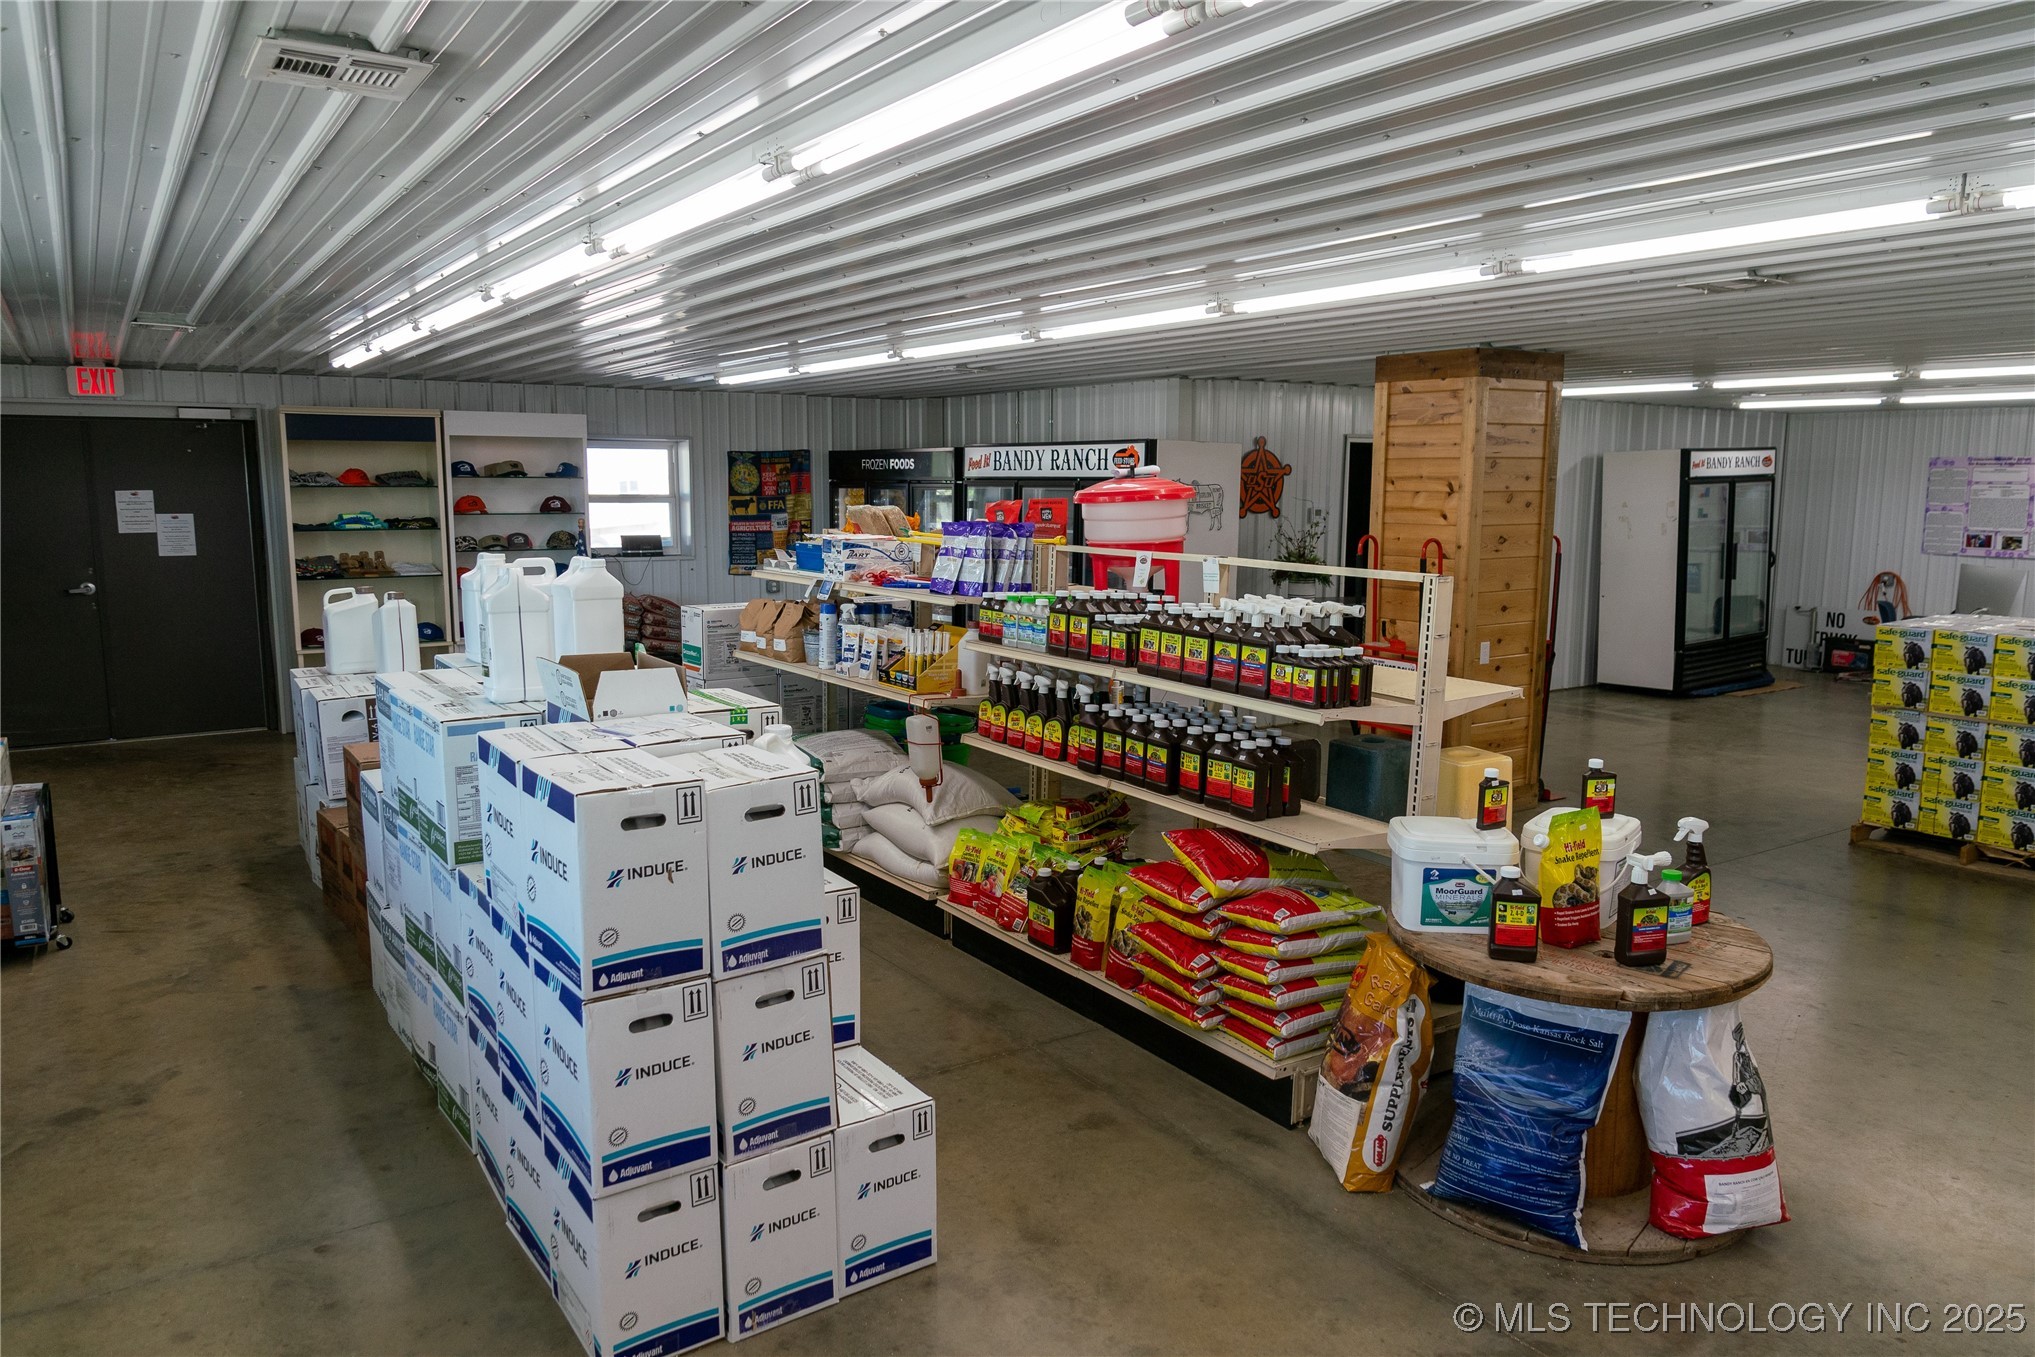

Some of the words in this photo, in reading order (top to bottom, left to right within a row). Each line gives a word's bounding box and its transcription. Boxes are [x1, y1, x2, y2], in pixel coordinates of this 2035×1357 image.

[75, 367, 116, 395] EXIT
[861, 458, 889, 470] FROZEN
[889, 458, 915, 470] FOODS
[993, 448, 1046, 471] BANDY
[1049, 448, 1109, 471] RANCH
[1706, 456, 1733, 469] BANDY
[1735, 455, 1760, 468] RANCH
[768, 500, 785, 510] FFA
[1826, 611, 1846, 629] NO
[1878, 628, 1927, 639] safe-guard
[1938, 631, 1988, 643] safe-guard
[1877, 667, 1925, 679] safe-guard
[1936, 673, 1986, 686] safe-guard
[1871, 747, 1918, 760] safe-guard
[1927, 755, 1977, 770] safe-guard
[1868, 784, 1914, 799] safe-guard
[1924, 796, 1973, 810] safe-guard
[1564, 839, 1586, 852] Hi-Yield
[539, 846, 568, 881] INDUCE
[751, 848, 803, 869] INDUCE
[1554, 853, 1575, 865] Snake
[1575, 848, 1600, 861] Repellent
[627, 859, 685, 881] INDUCE
[738, 949, 769, 965] Adjuvant
[610, 967, 644, 984] Adjuvant
[761, 1030, 811, 1054] INDUCE
[1532, 1024, 1562, 1040] Kansas
[1563, 1032, 1586, 1046] Rock
[1588, 1038, 1604, 1050] Salt
[552, 1041, 579, 1080] INDUCE
[635, 1055, 691, 1080] INDUCE
[1382, 1017, 1415, 1132] SUPPLEMENTS
[749, 1129, 779, 1146] Adjuvant
[516, 1146, 542, 1189] INDUCE
[620, 1161, 653, 1178] Adjuvant
[1452, 1153, 1461, 1162] NO
[1462, 1157, 1483, 1170] TREAT
[873, 1169, 918, 1193] INDUCE
[768, 1207, 817, 1234] INDUCE
[560, 1217, 589, 1268] INDUCE
[644, 1238, 699, 1267] INDUCE
[859, 1262, 885, 1279] Adjuvant
